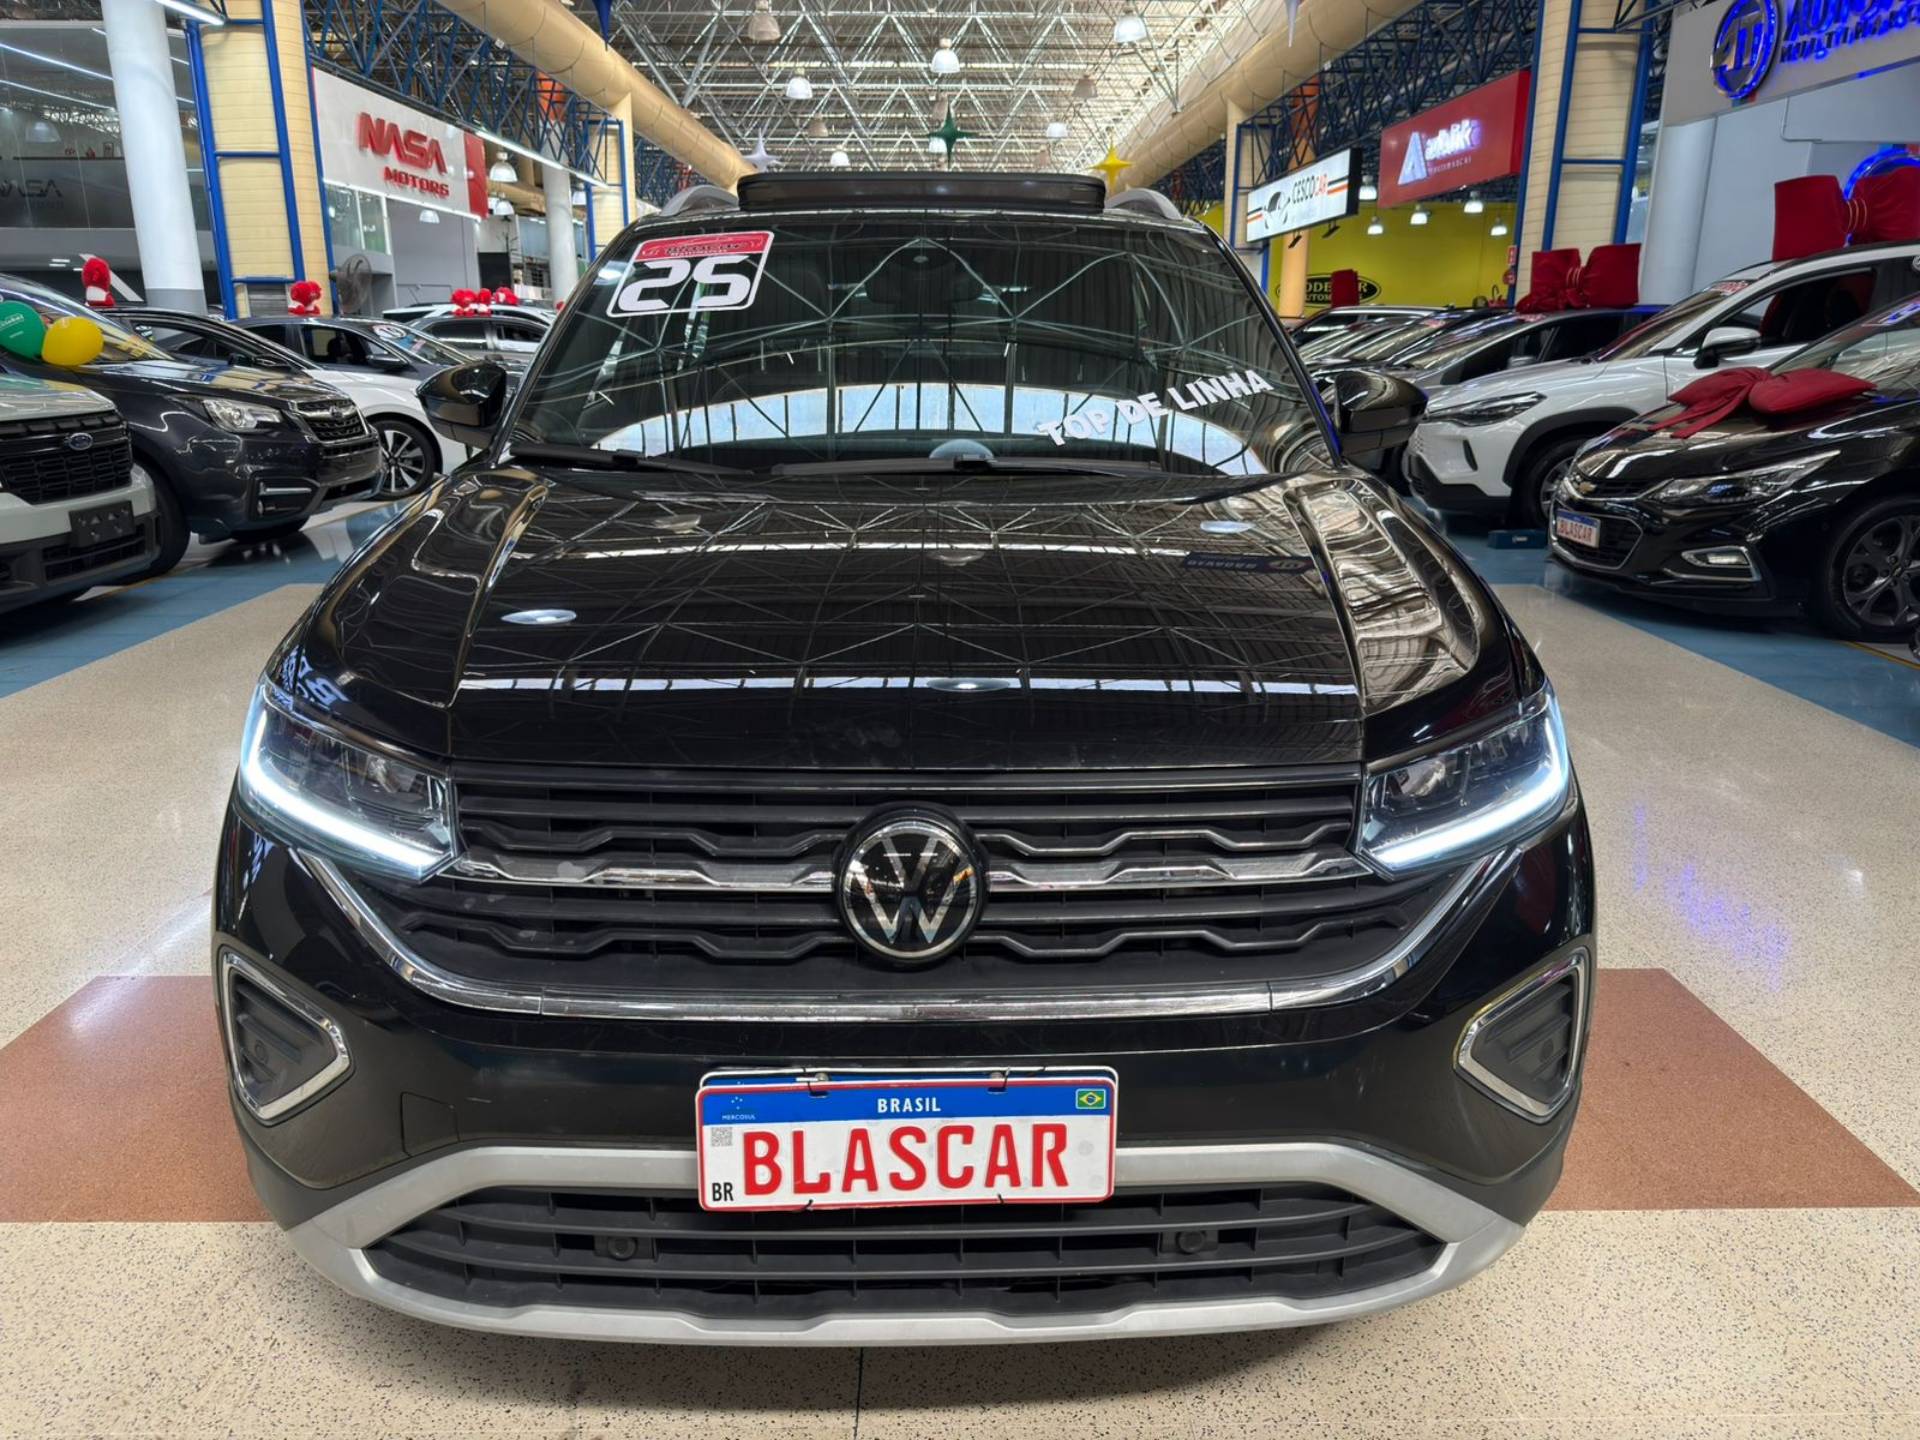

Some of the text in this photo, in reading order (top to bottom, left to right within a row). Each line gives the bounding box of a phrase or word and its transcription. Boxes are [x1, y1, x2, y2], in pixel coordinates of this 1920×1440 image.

[357, 112, 447, 176] NASA
[383, 166, 449, 198] MOTORS
[618, 255, 751, 312] 25
[1036, 369, 1274, 447] TOP DE LINHA
[877, 1097, 941, 1113] BRASIL
[743, 1123, 1070, 1196] BLASCAR
[711, 1182, 734, 1202] BR
